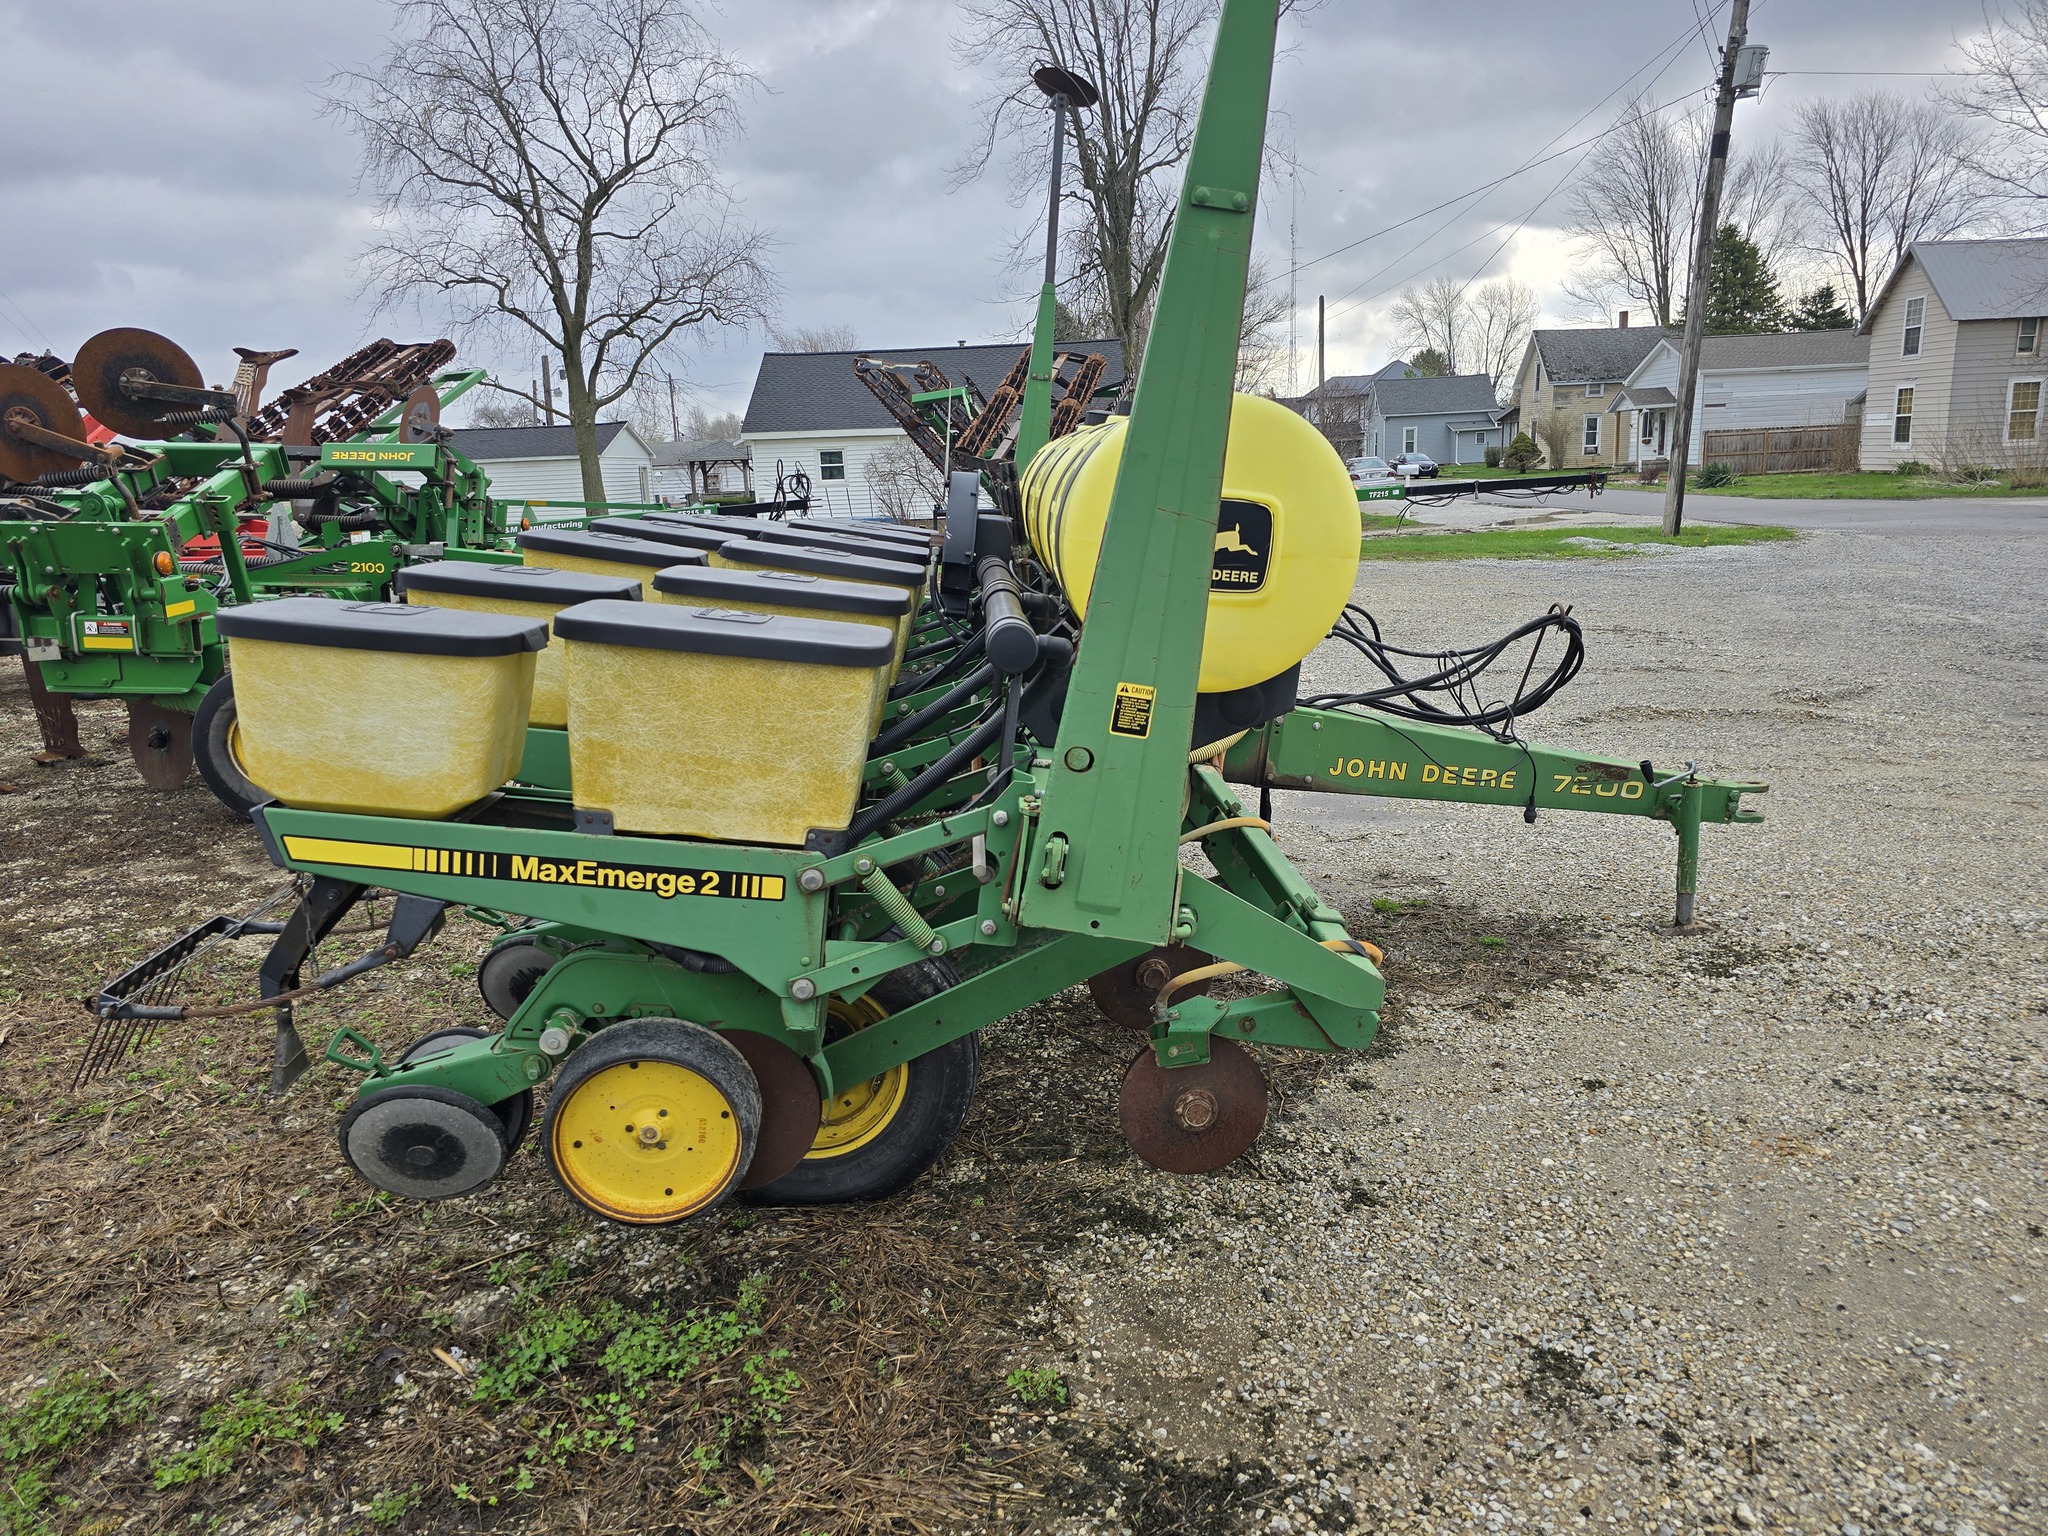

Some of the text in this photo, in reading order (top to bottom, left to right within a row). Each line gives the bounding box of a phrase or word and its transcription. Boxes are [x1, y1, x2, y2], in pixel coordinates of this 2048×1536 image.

[331, 451, 415, 462] JOHN DEERE
[1368, 490, 1389, 498] TF215
[521, 520, 584, 534] anufacturing
[350, 561, 385, 574] 2100
[1211, 568, 1259, 584] DEERE
[1328, 756, 1517, 789] JOHN DEERE
[1552, 773, 1645, 800] 7200
[511, 855, 720, 898] MaxEmerge 2
